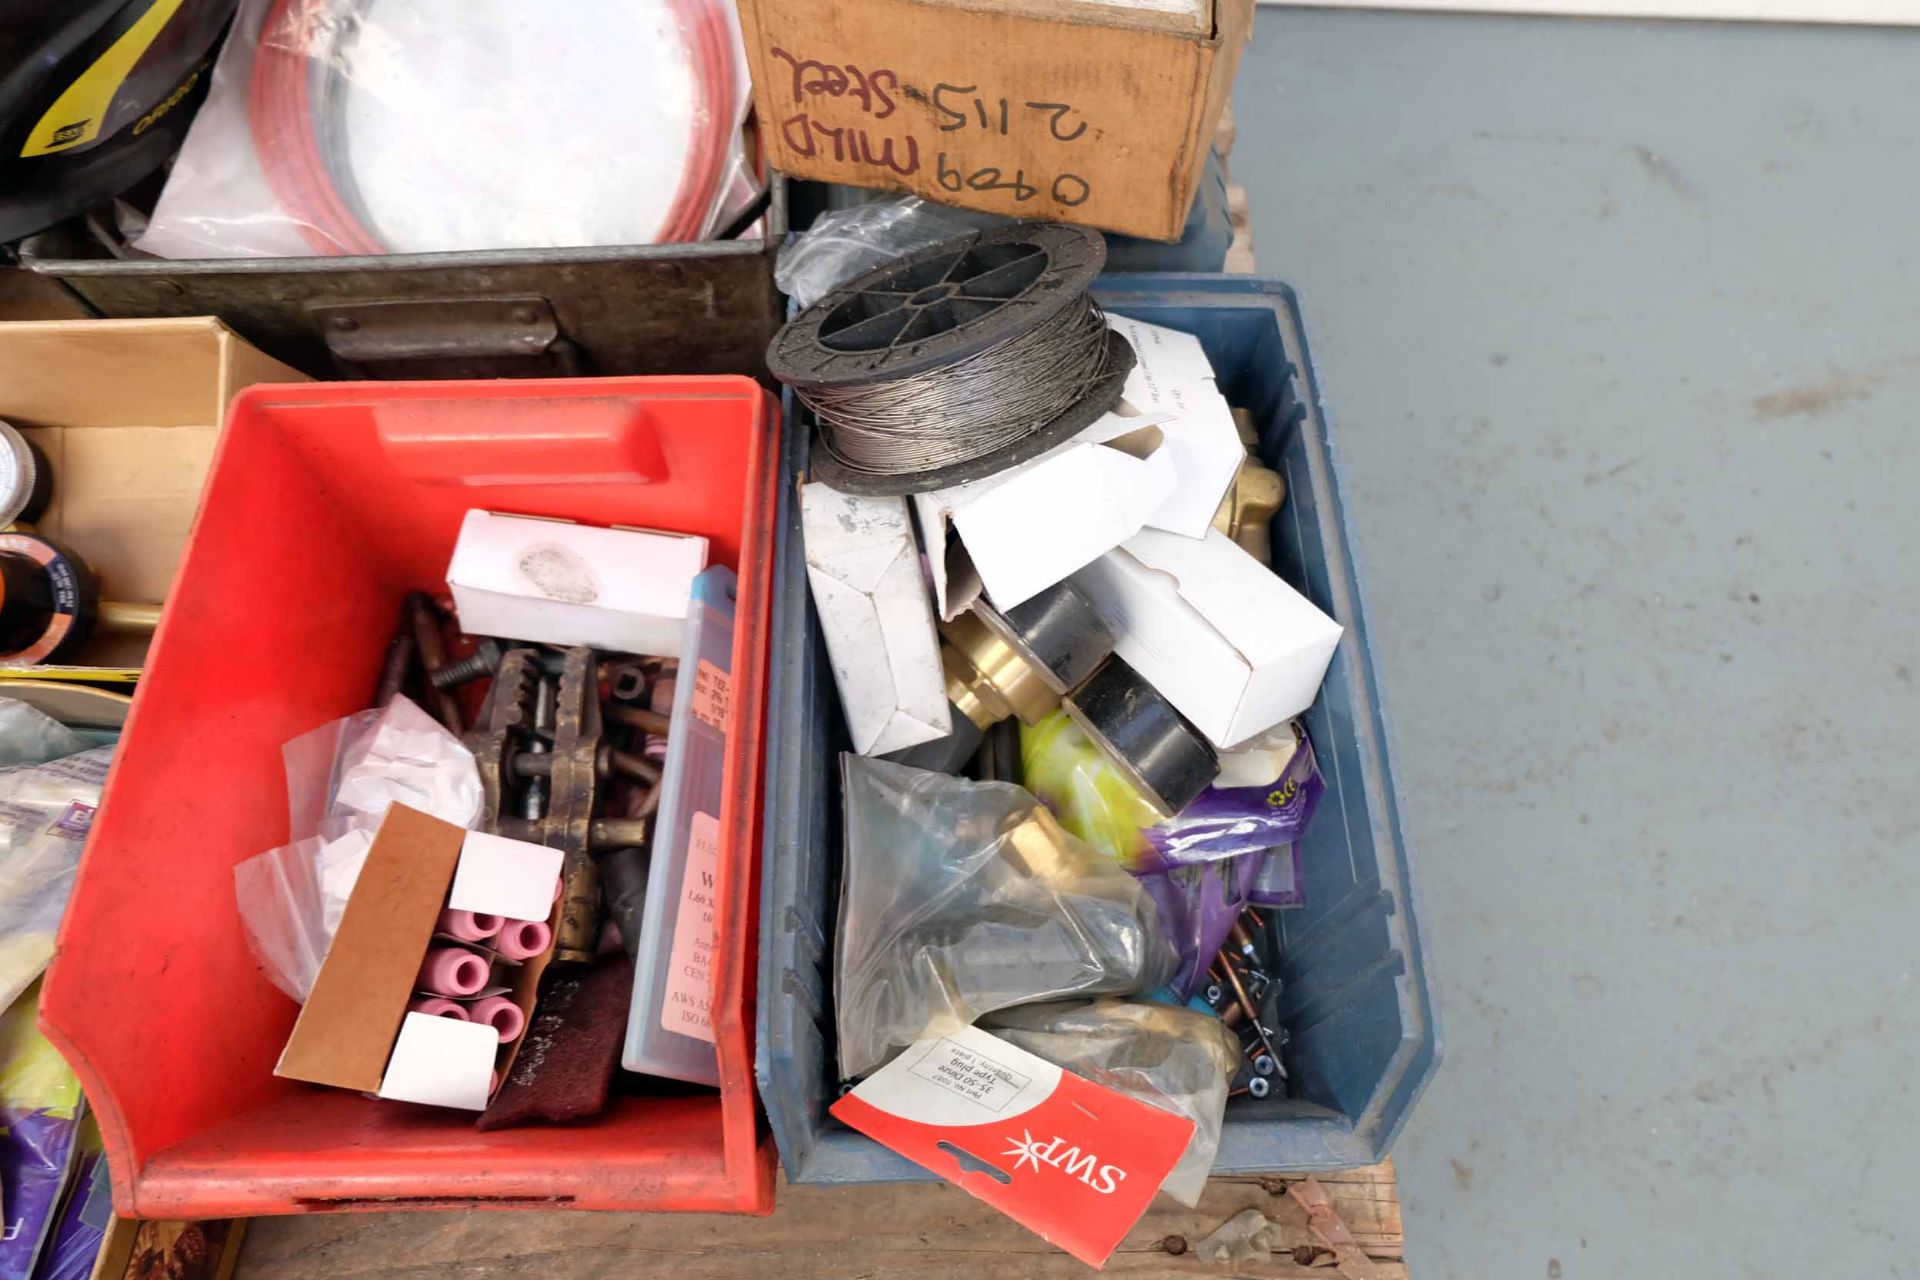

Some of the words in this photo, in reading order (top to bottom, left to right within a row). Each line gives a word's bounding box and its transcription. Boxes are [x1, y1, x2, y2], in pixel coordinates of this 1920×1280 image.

[771, 46, 898, 120] Steel
[937, 1064, 964, 1081] Dinze
[950, 1057, 974, 1073] plug
[963, 1076, 994, 1094] 35-50
[973, 1069, 996, 1085] Type
[1029, 1135, 1126, 1194] SWP
